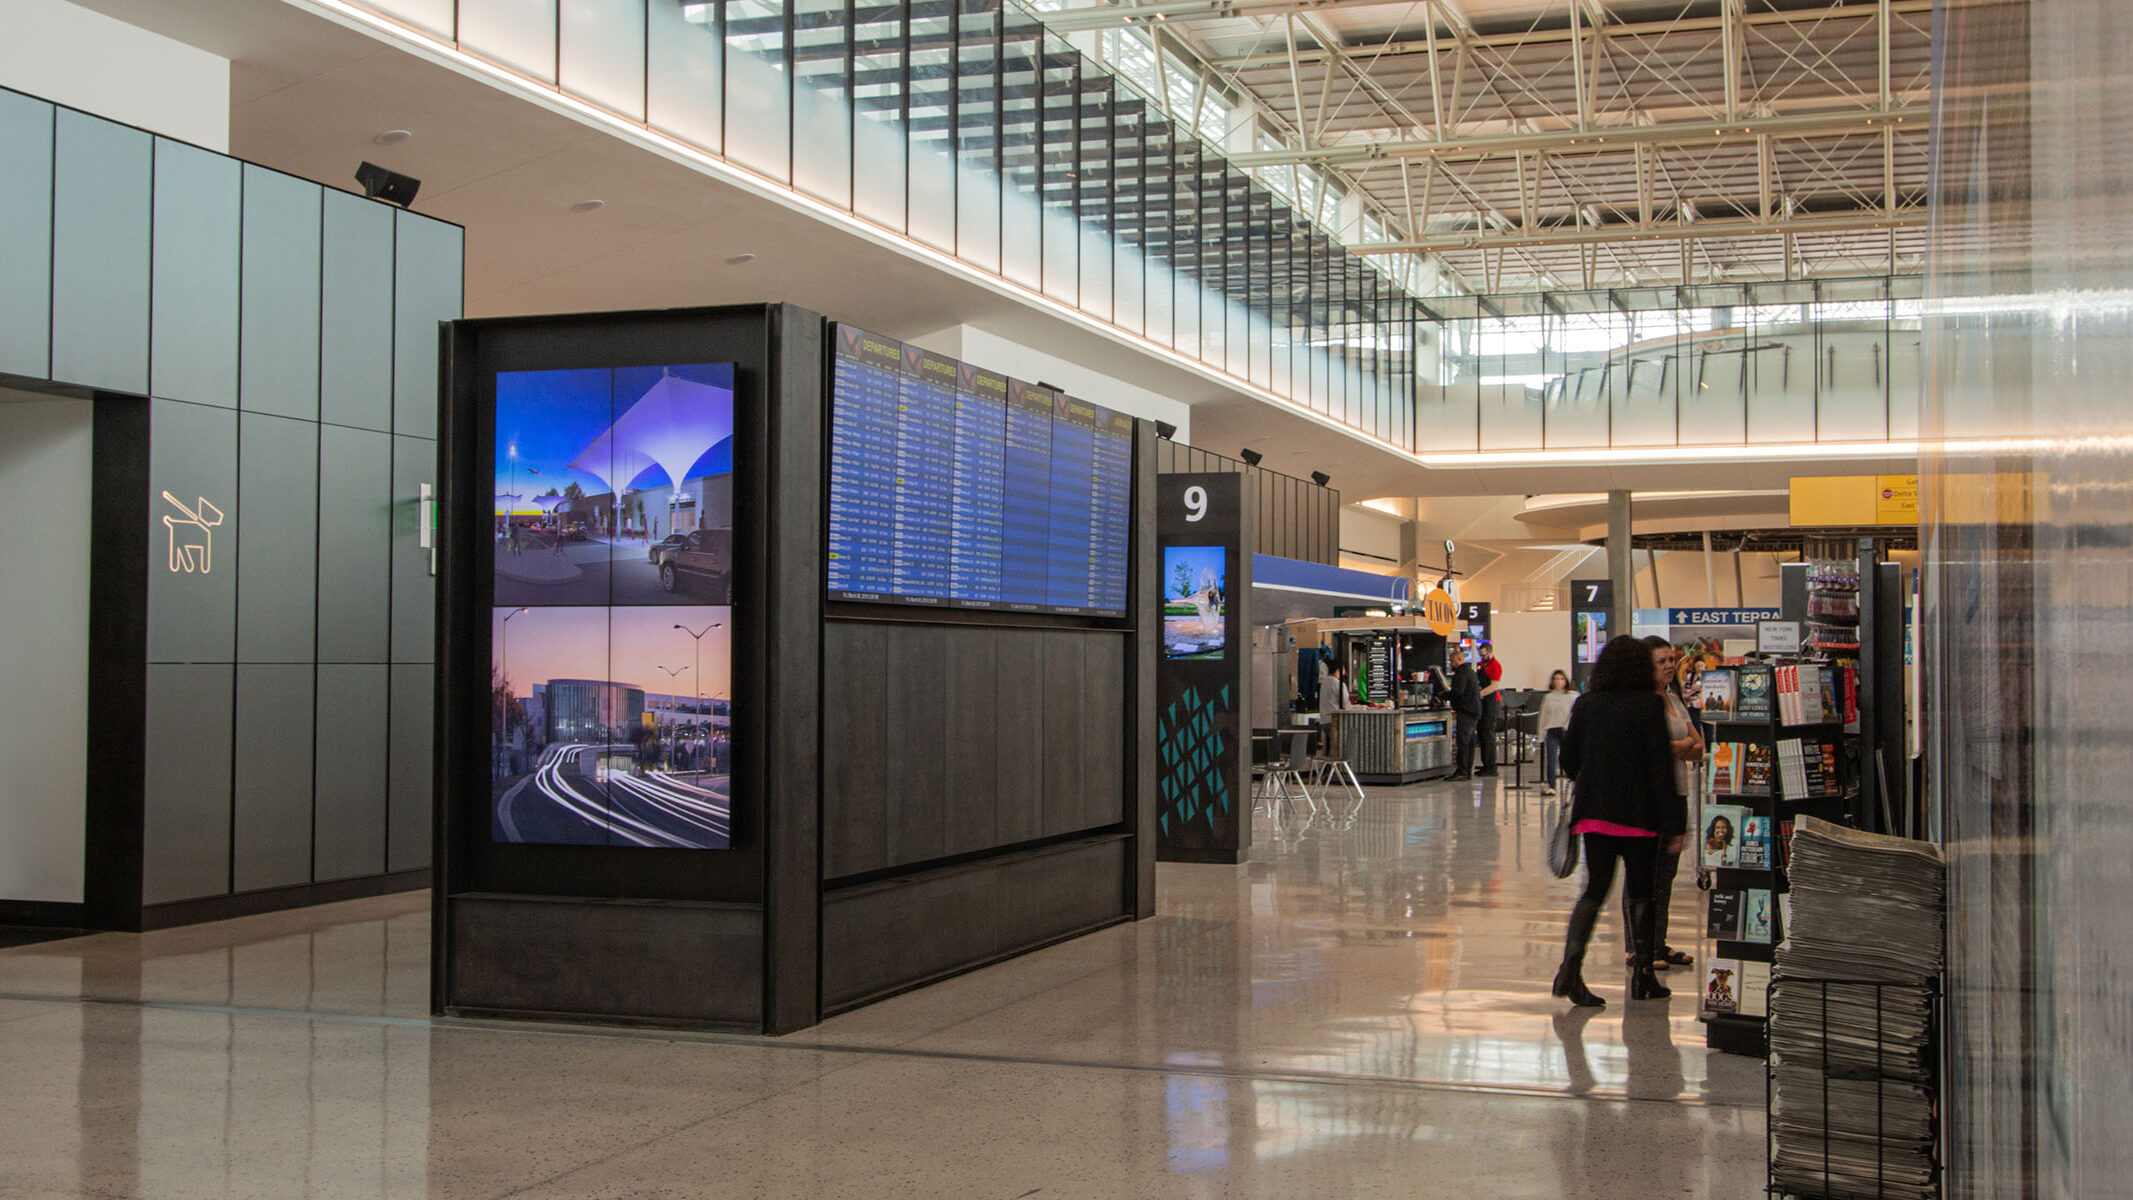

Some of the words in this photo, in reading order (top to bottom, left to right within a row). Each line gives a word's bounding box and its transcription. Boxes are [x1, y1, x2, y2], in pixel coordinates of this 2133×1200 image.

[862, 339, 900, 361] DEPARTURES
[923, 358, 957, 377] DEPARTURES
[1183, 485, 1208, 522] 9
[1586, 585, 1599, 603] 7
[1428, 599, 1455, 624] TACOS
[1469, 605, 1478, 619] 5
[1692, 611, 1728, 623] EAST
